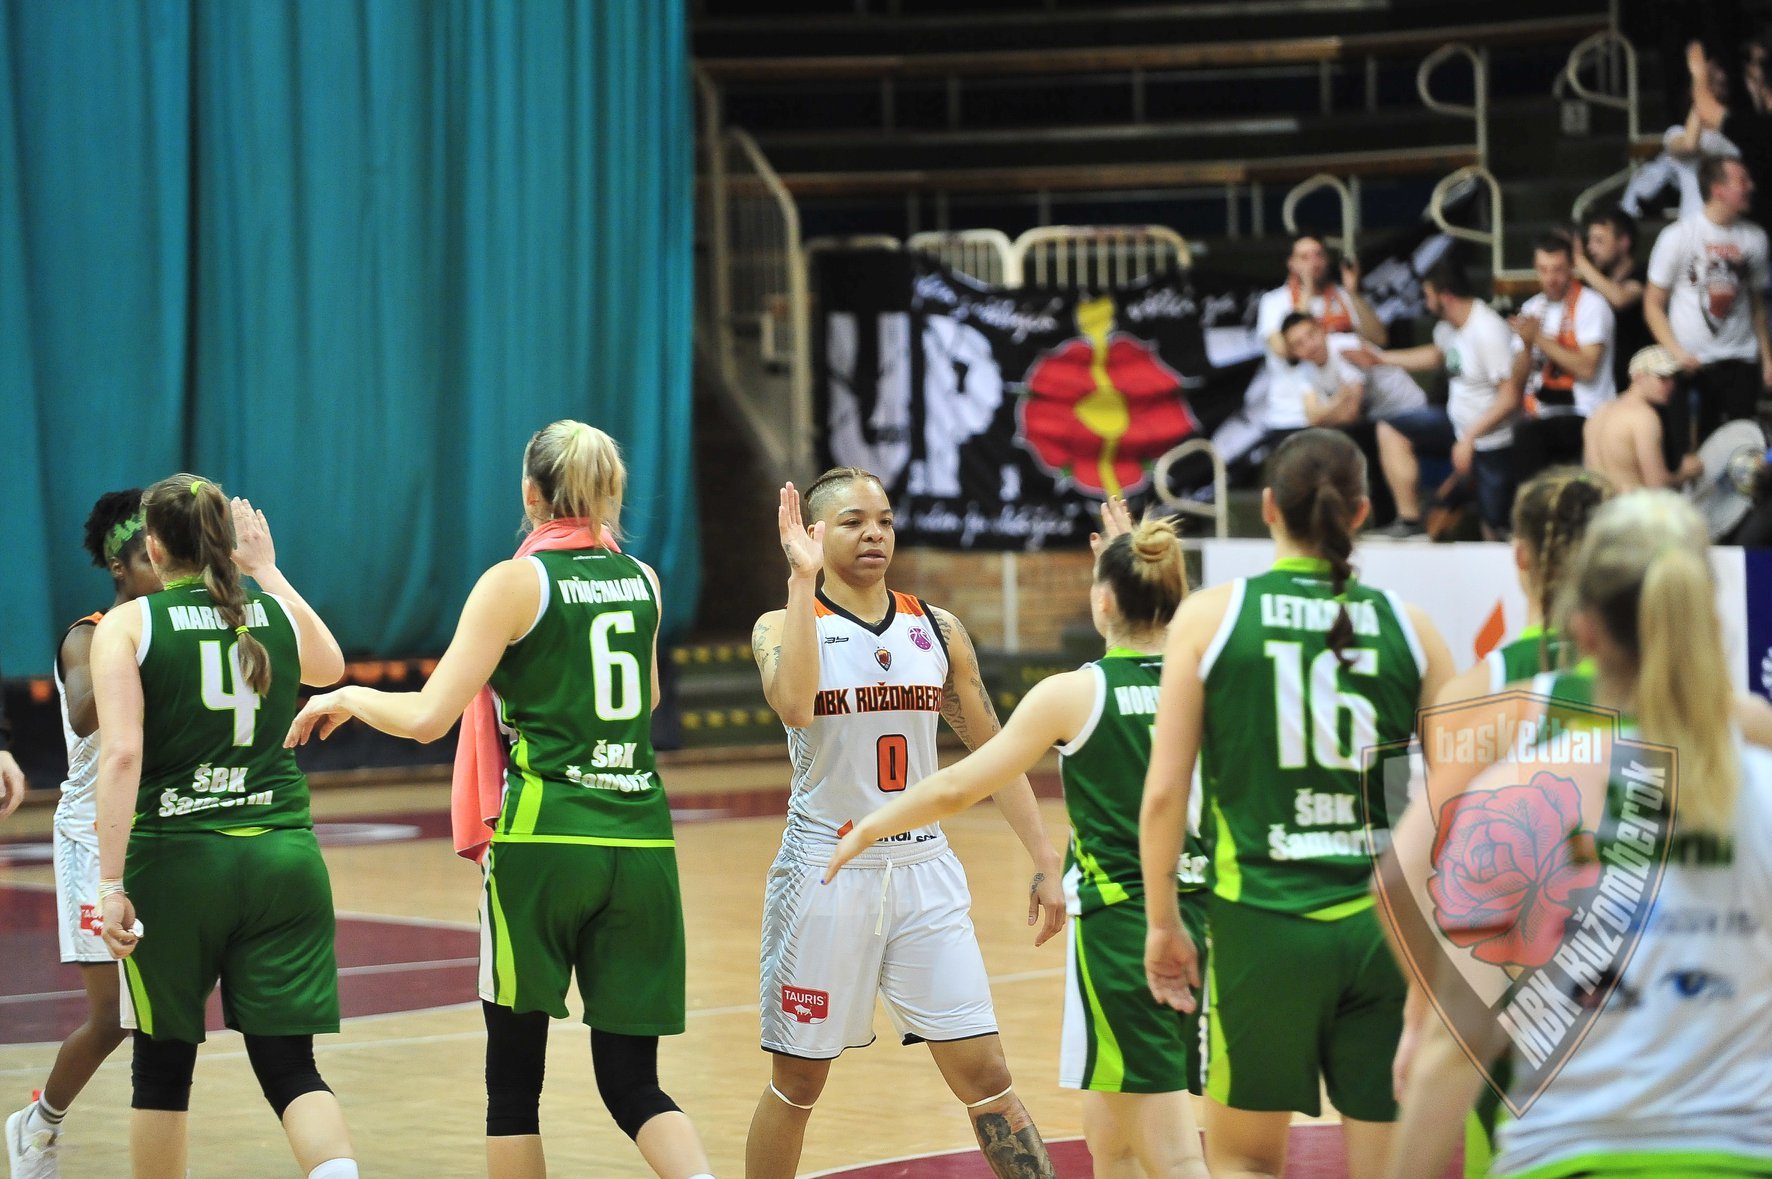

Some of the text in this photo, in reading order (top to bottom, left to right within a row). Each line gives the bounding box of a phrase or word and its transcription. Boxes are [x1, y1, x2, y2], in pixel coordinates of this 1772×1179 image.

[589, 610, 641, 721] 6
[199, 640, 261, 747] 4
[814, 688, 851, 716] MBK
[1263, 640, 1379, 772] 16
[591, 739, 637, 768] ŠBK
[876, 733, 908, 792] 0
[192, 762, 248, 793] ŠBK
[1294, 788, 1356, 826] ŠBK
[784, 989, 825, 1006] TAURIS
